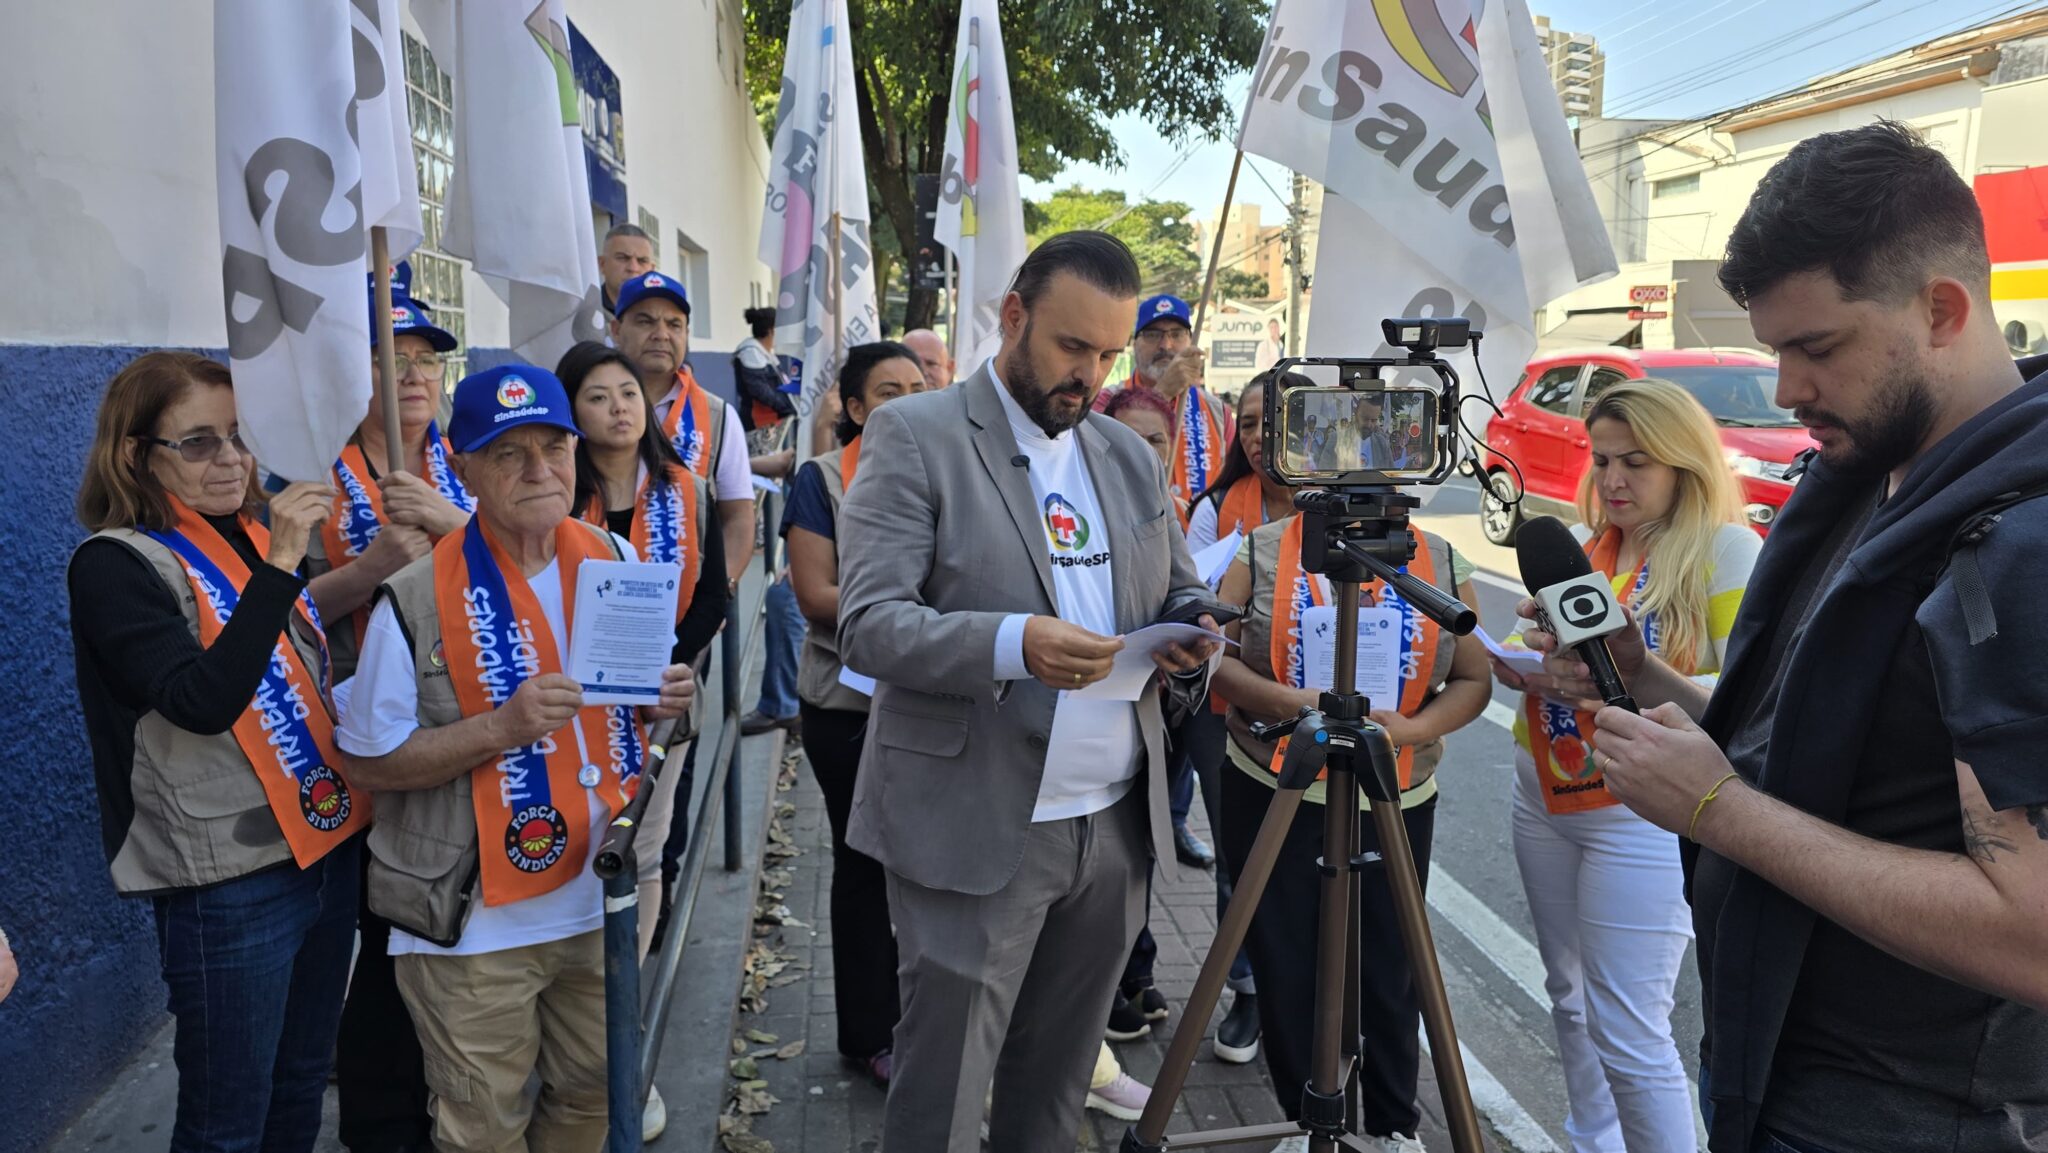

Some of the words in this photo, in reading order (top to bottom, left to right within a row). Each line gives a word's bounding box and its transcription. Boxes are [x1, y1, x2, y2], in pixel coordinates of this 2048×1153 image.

[1633, 287, 1667, 302] OXXO
[359, 508, 376, 521] O
[1287, 626, 1302, 640] A
[1398, 650, 1425, 680] DA
[283, 682, 311, 721] DA
[1551, 778, 1605, 796] SinSaúdeS
[307, 791, 350, 830] SINDICAL
[507, 836, 567, 873] SINDICAL
